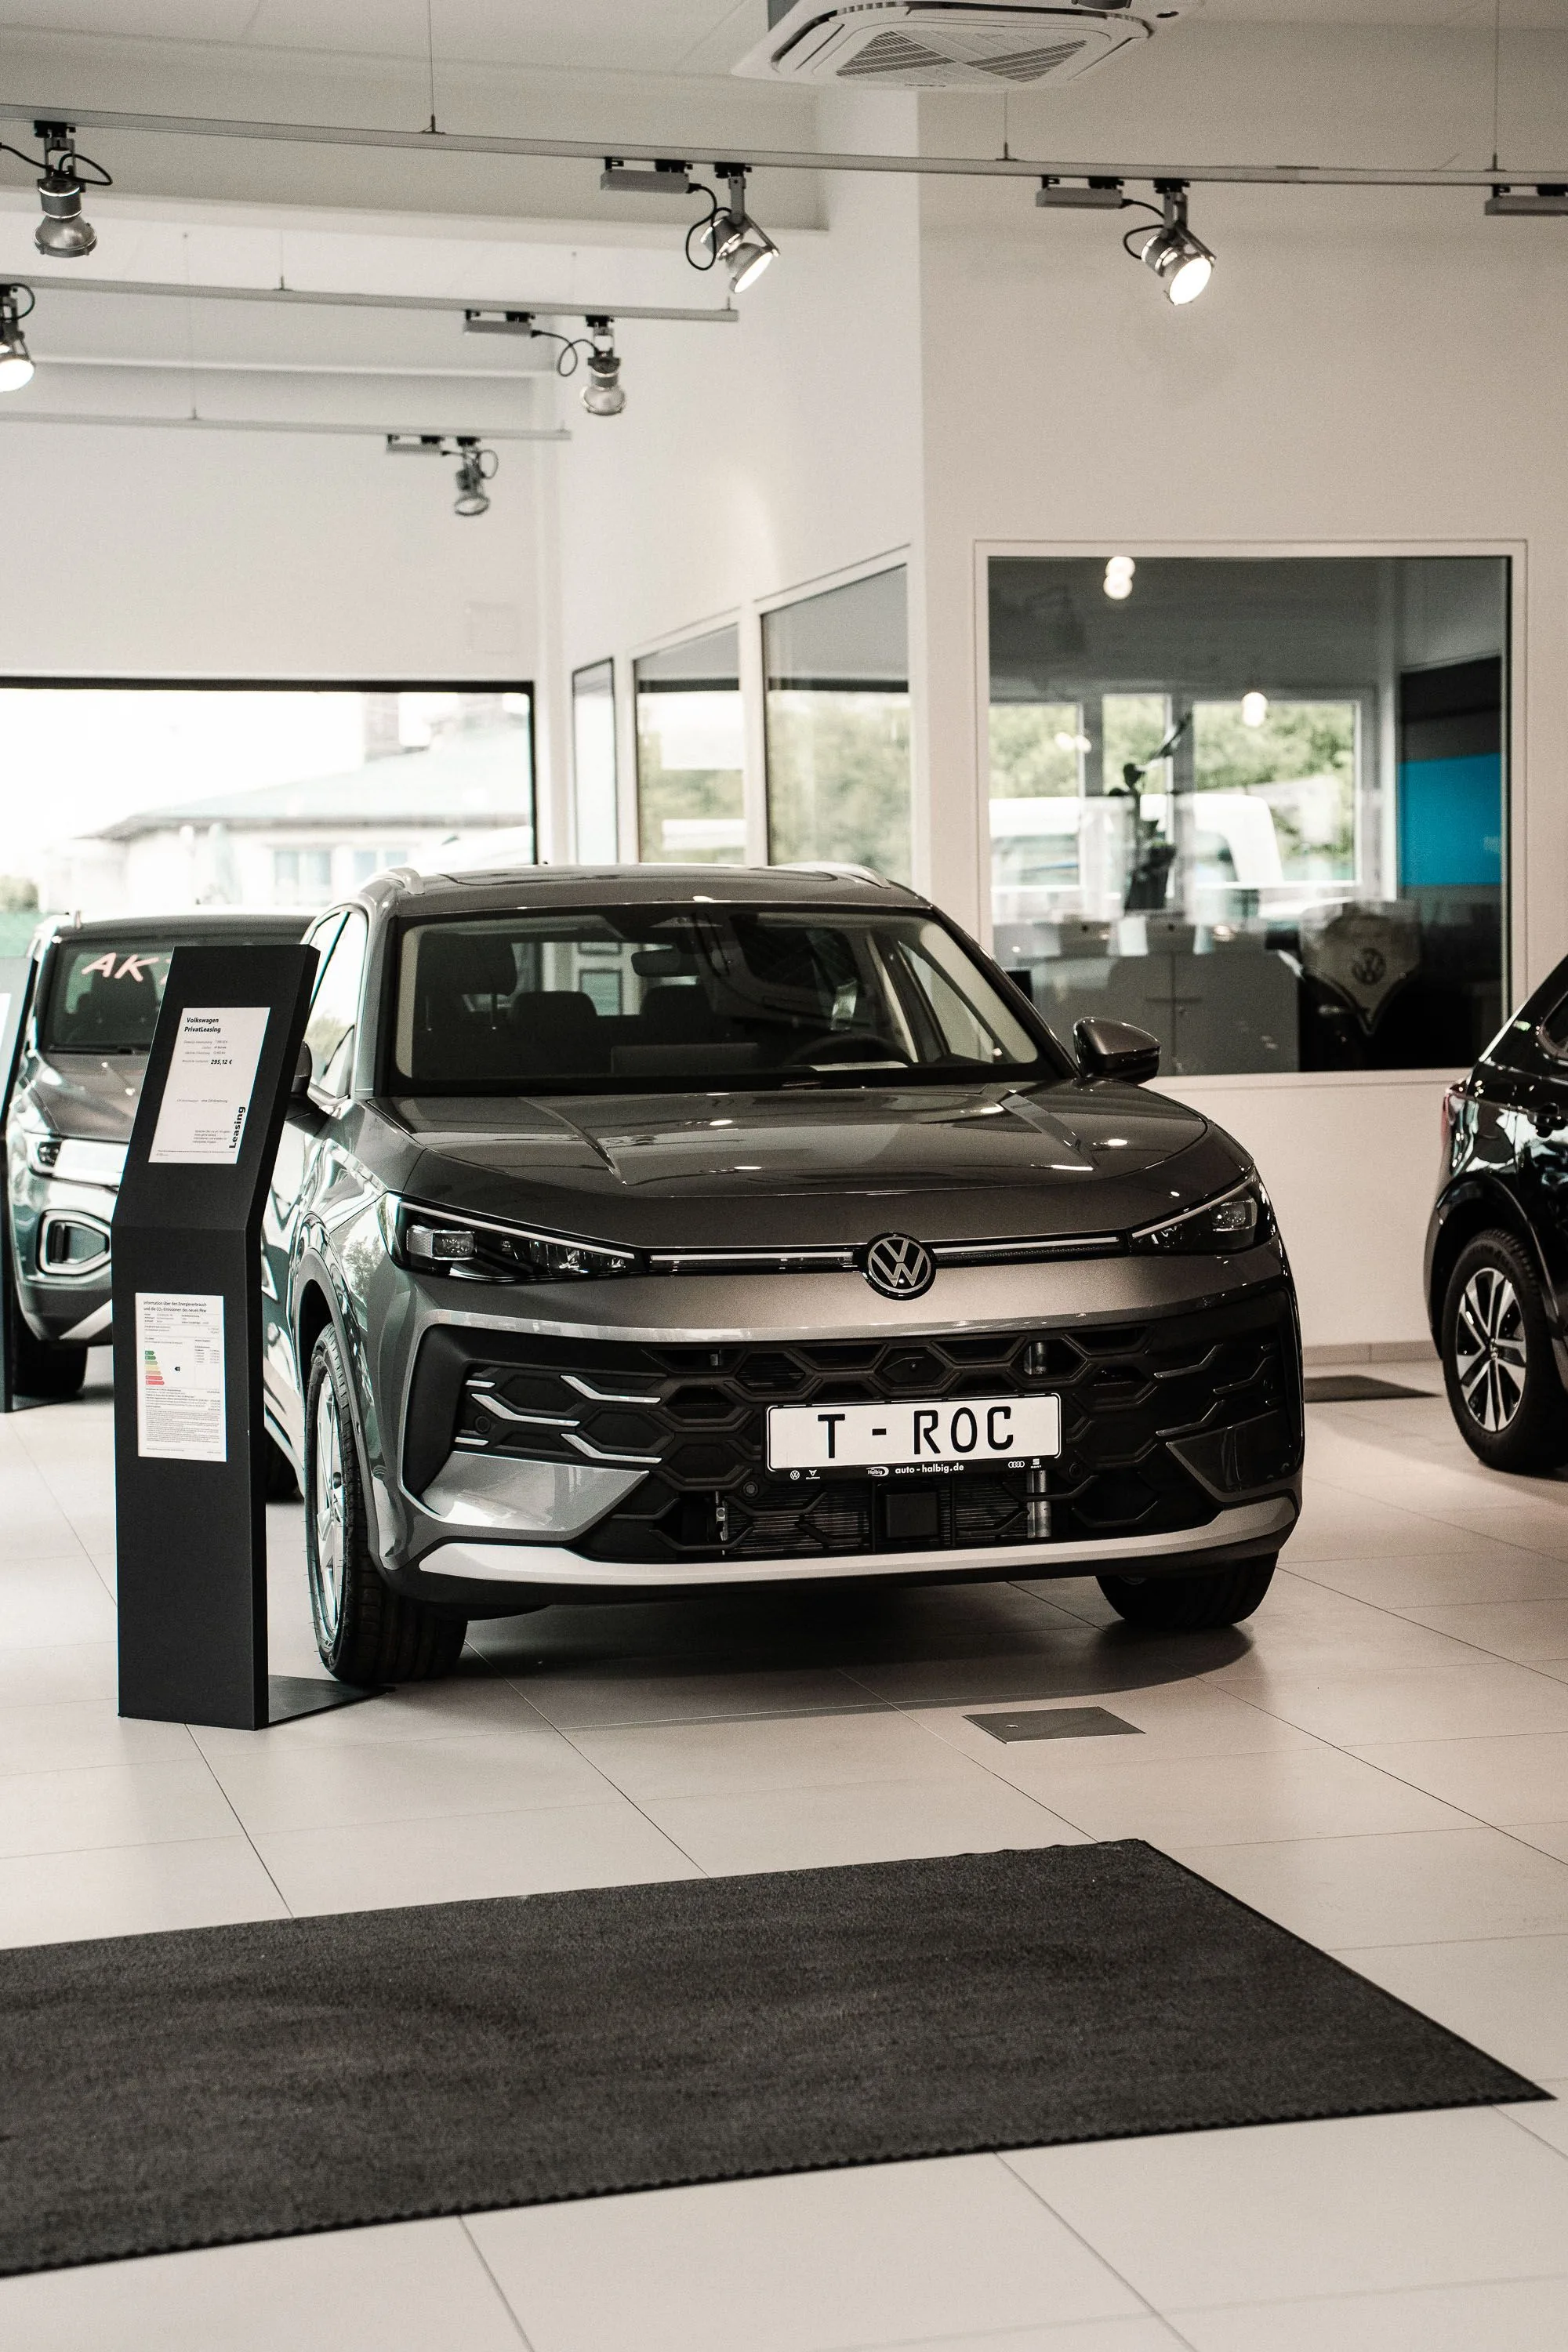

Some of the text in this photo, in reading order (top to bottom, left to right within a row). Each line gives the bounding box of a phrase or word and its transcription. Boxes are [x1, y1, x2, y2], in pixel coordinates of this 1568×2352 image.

[82, 953, 171, 985] AK
[229, 1106, 246, 1149] Leasing
[867, 1236, 931, 1294] VW
